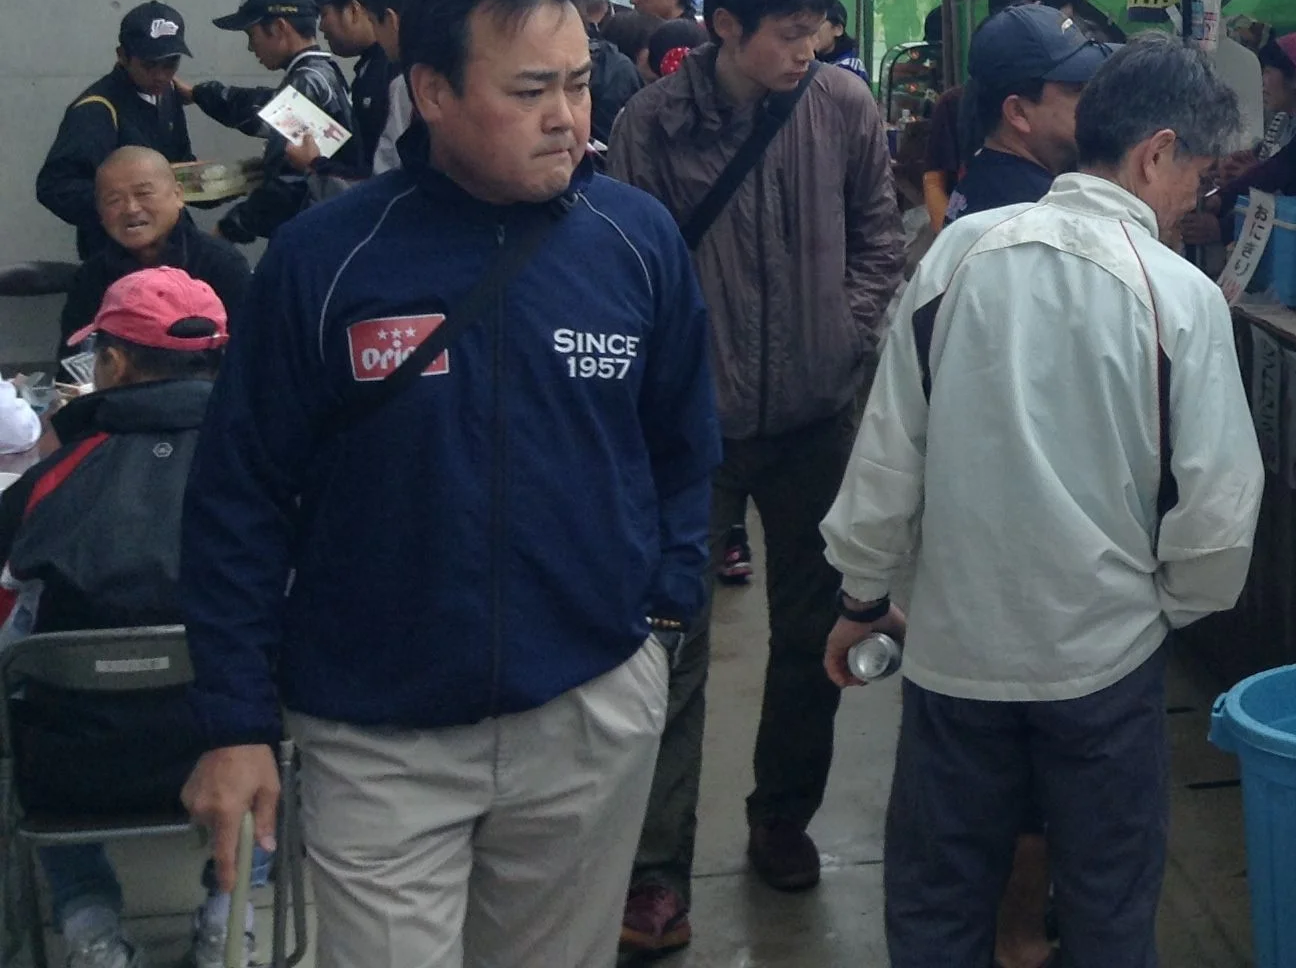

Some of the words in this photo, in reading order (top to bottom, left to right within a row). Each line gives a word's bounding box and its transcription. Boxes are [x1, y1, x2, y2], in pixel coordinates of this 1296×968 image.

[361, 339, 420, 371] Ori
[553, 328, 640, 358] SINCE
[566, 357, 632, 380] 1957
